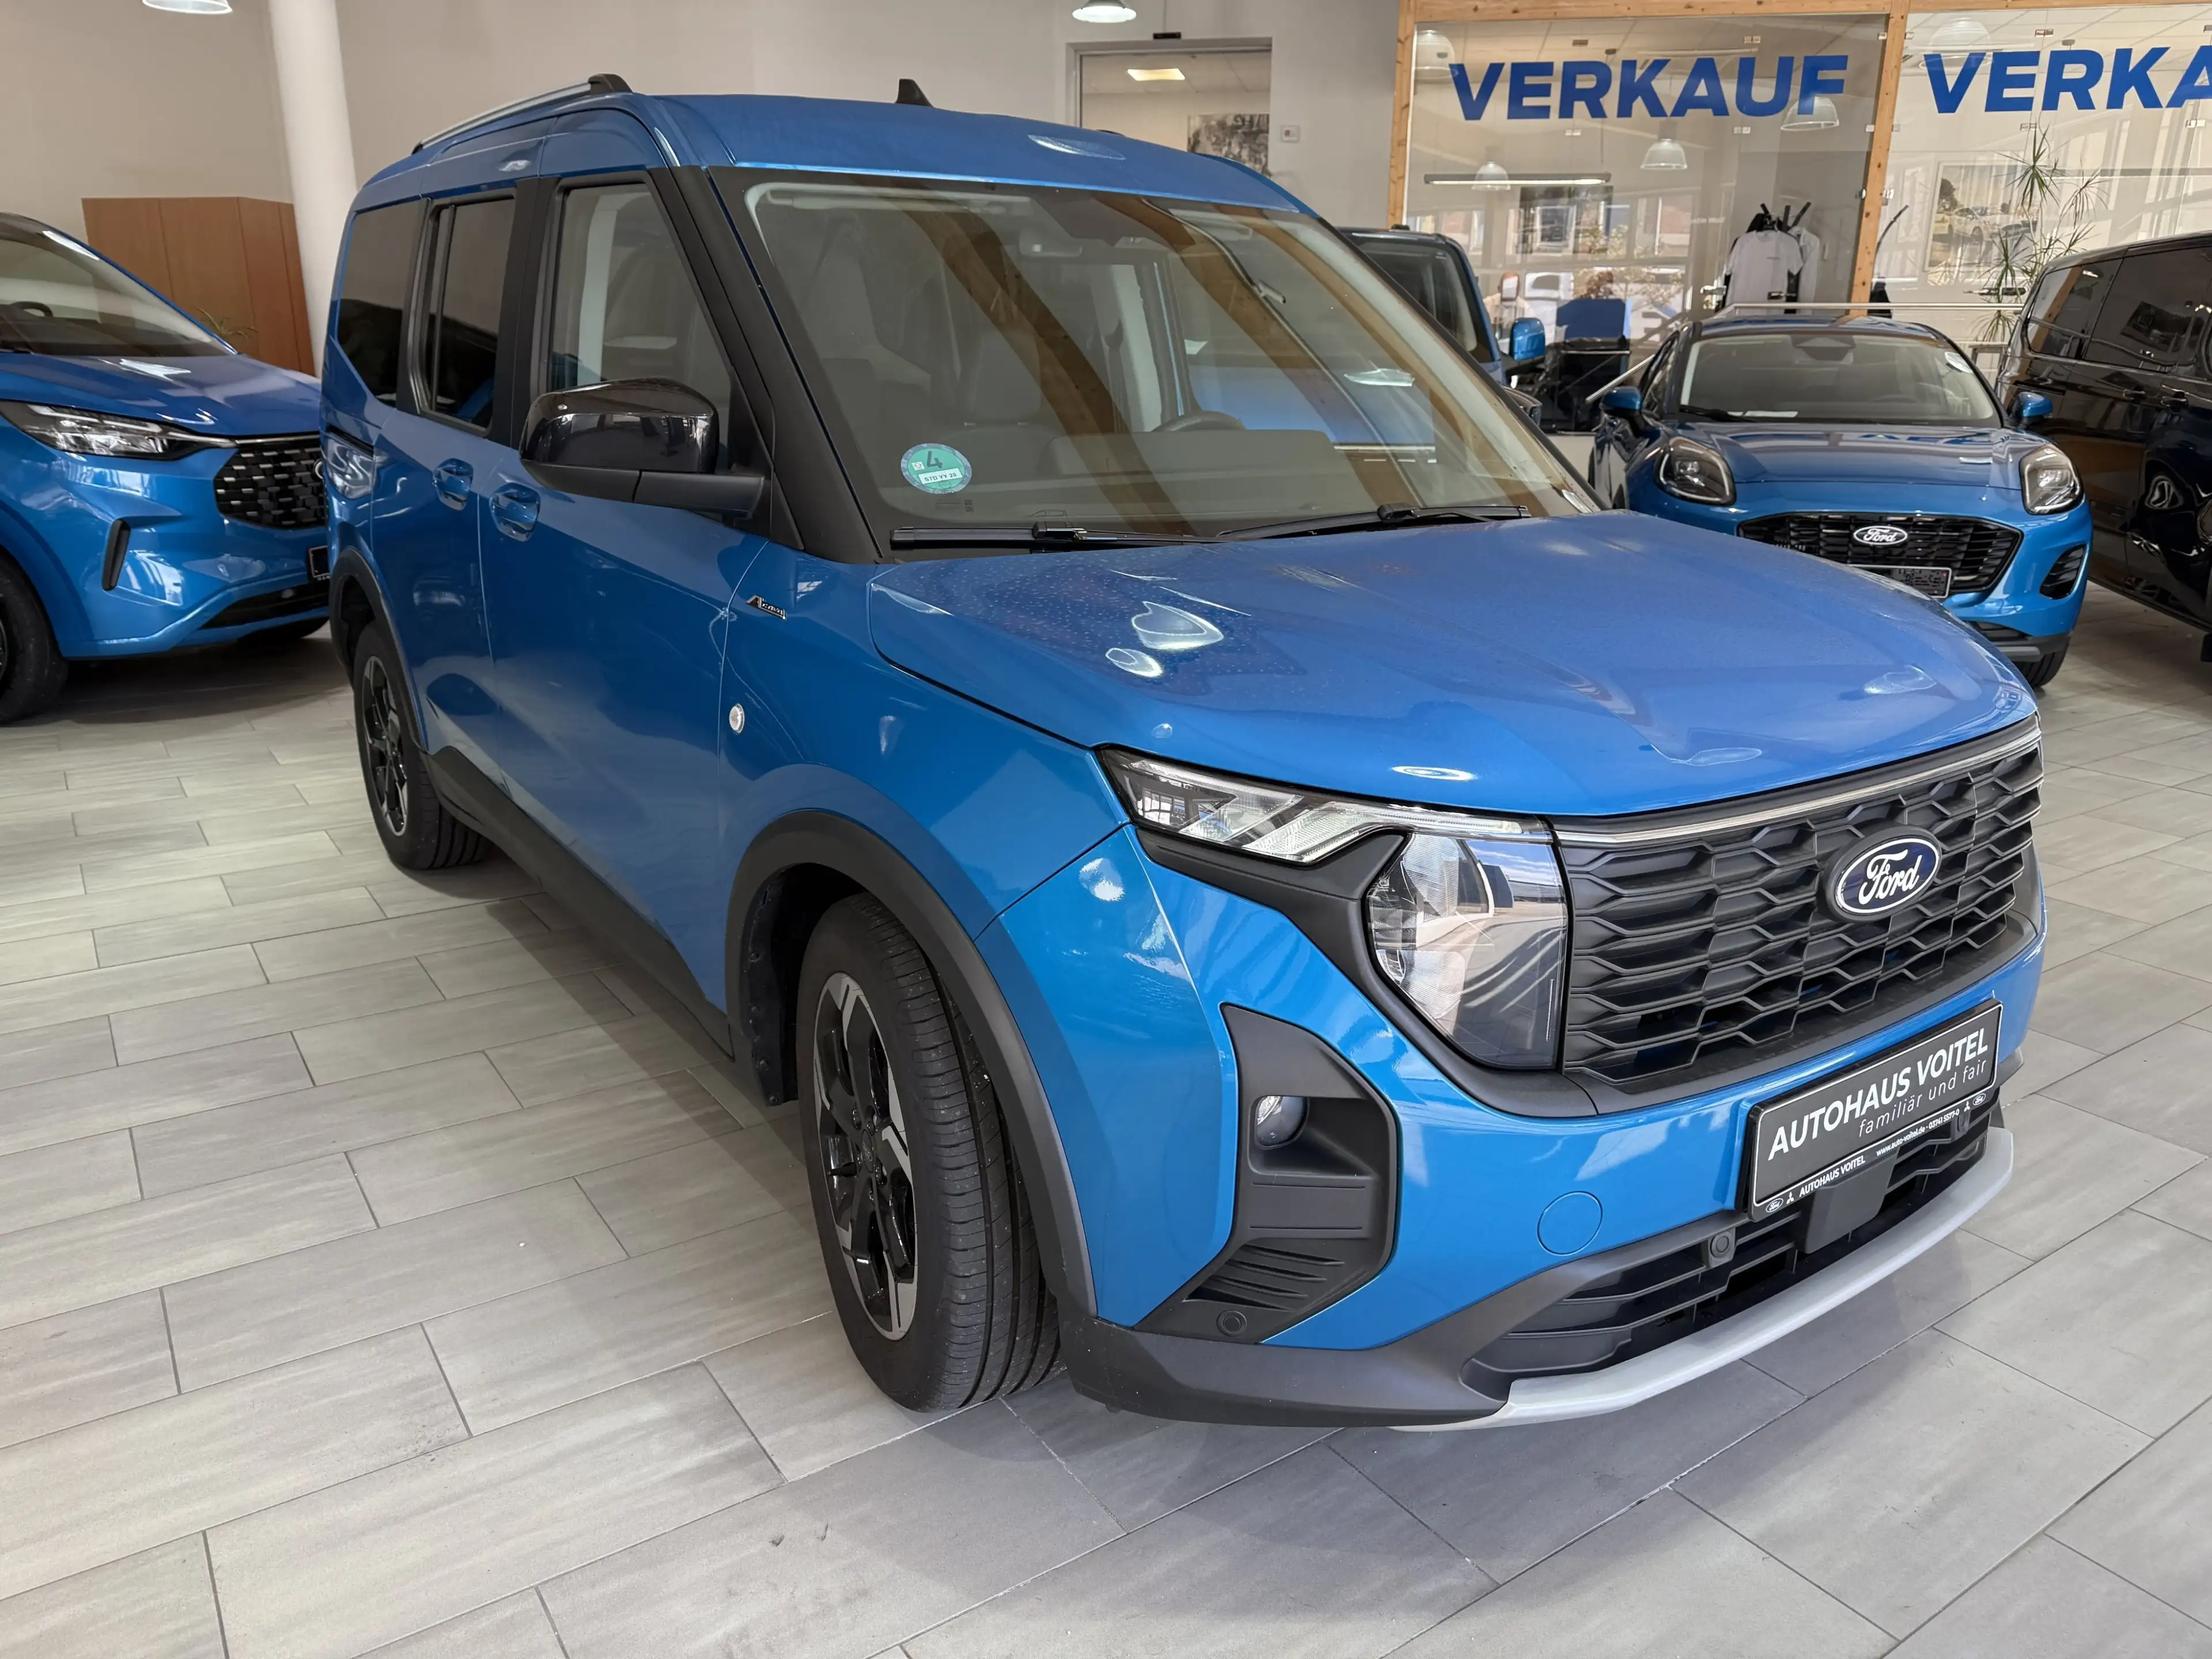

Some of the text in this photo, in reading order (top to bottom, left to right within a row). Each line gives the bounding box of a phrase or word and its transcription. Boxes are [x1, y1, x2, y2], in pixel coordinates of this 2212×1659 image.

[1449, 54, 1849, 121] VERKAUF
[1923, 46, 2212, 113] VERKA
[926, 451, 942, 468] 4
[1862, 528, 1898, 543] Ford
[1858, 849, 1923, 905] Ford
[1768, 1028, 1988, 1161] AUTOHAUS VOITEL
[1859, 1059, 1987, 1138] familiär und fair
[1798, 1168, 1840, 1198] AUTOHAUS
[1840, 1155, 1866, 1175] VOITEL
[1876, 1126, 1926, 1157] www.auto-voitel.de
